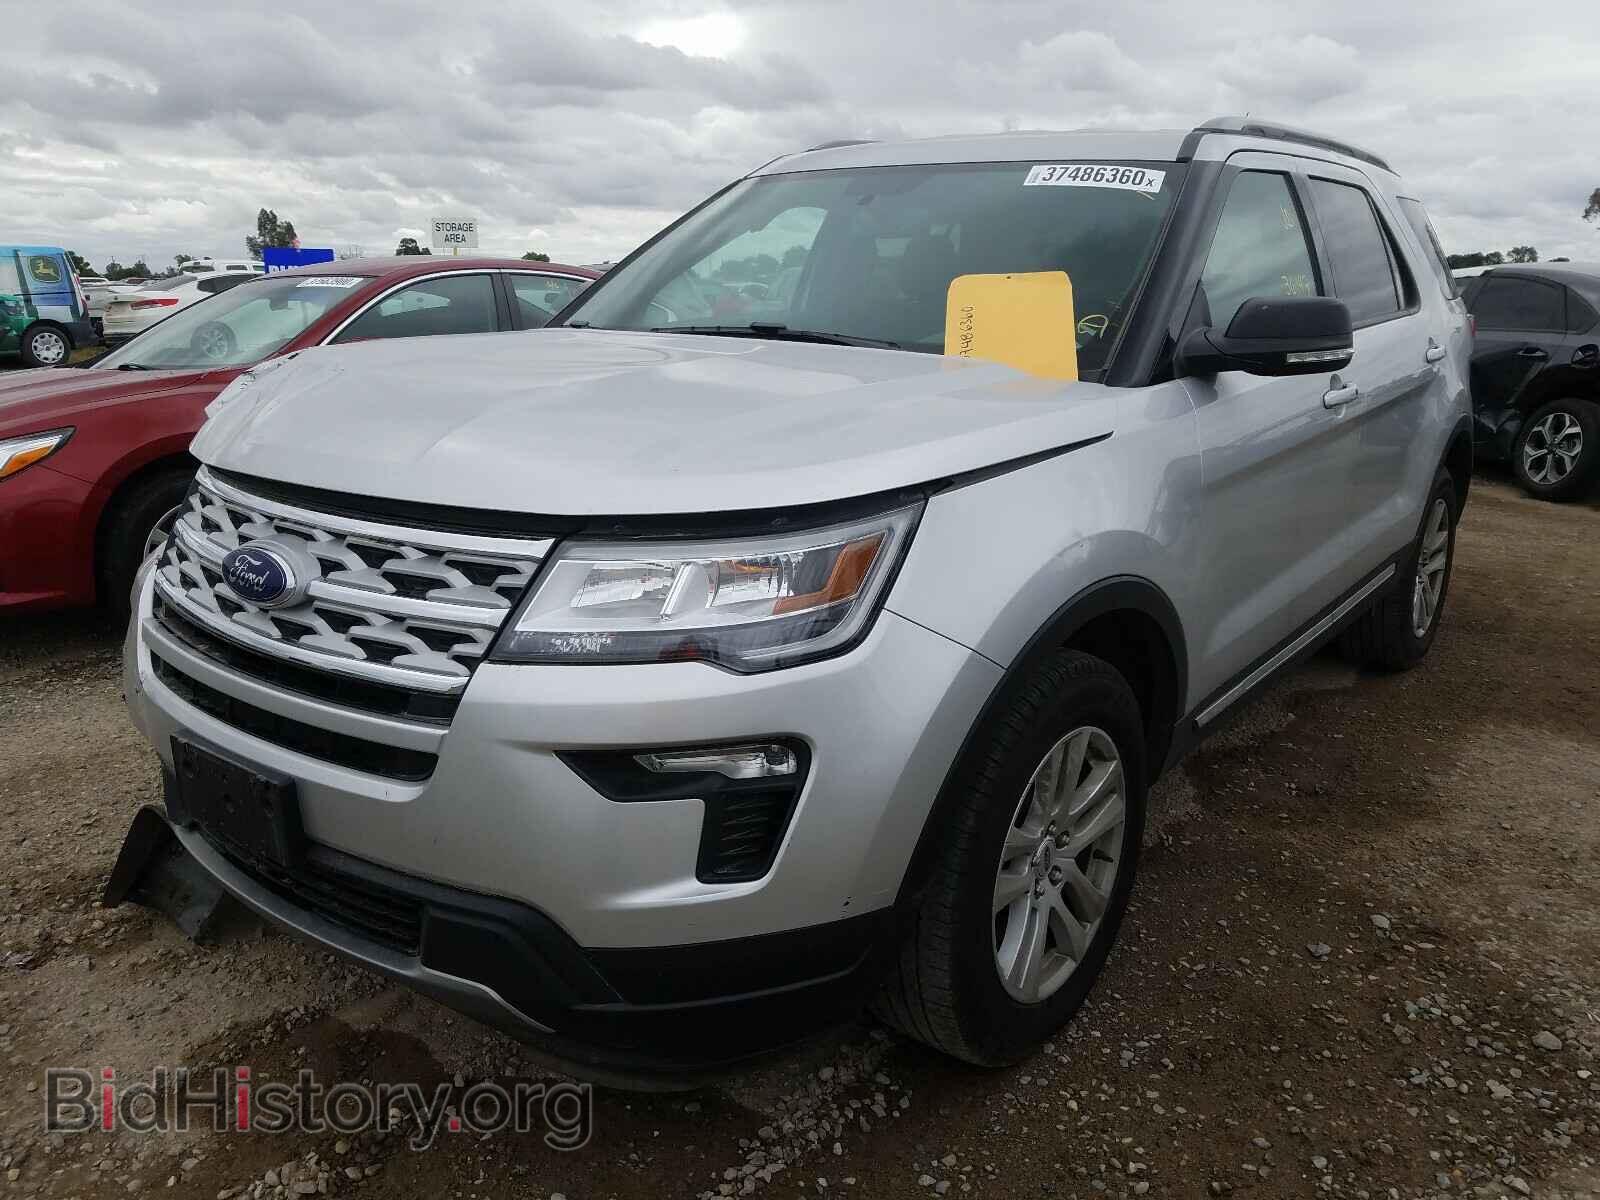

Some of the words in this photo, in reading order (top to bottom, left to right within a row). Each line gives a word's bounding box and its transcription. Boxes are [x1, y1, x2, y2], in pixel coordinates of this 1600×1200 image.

[435, 222, 474, 233] STORAGE
[444, 233, 467, 243] AREA
[229, 554, 270, 592] Ford
